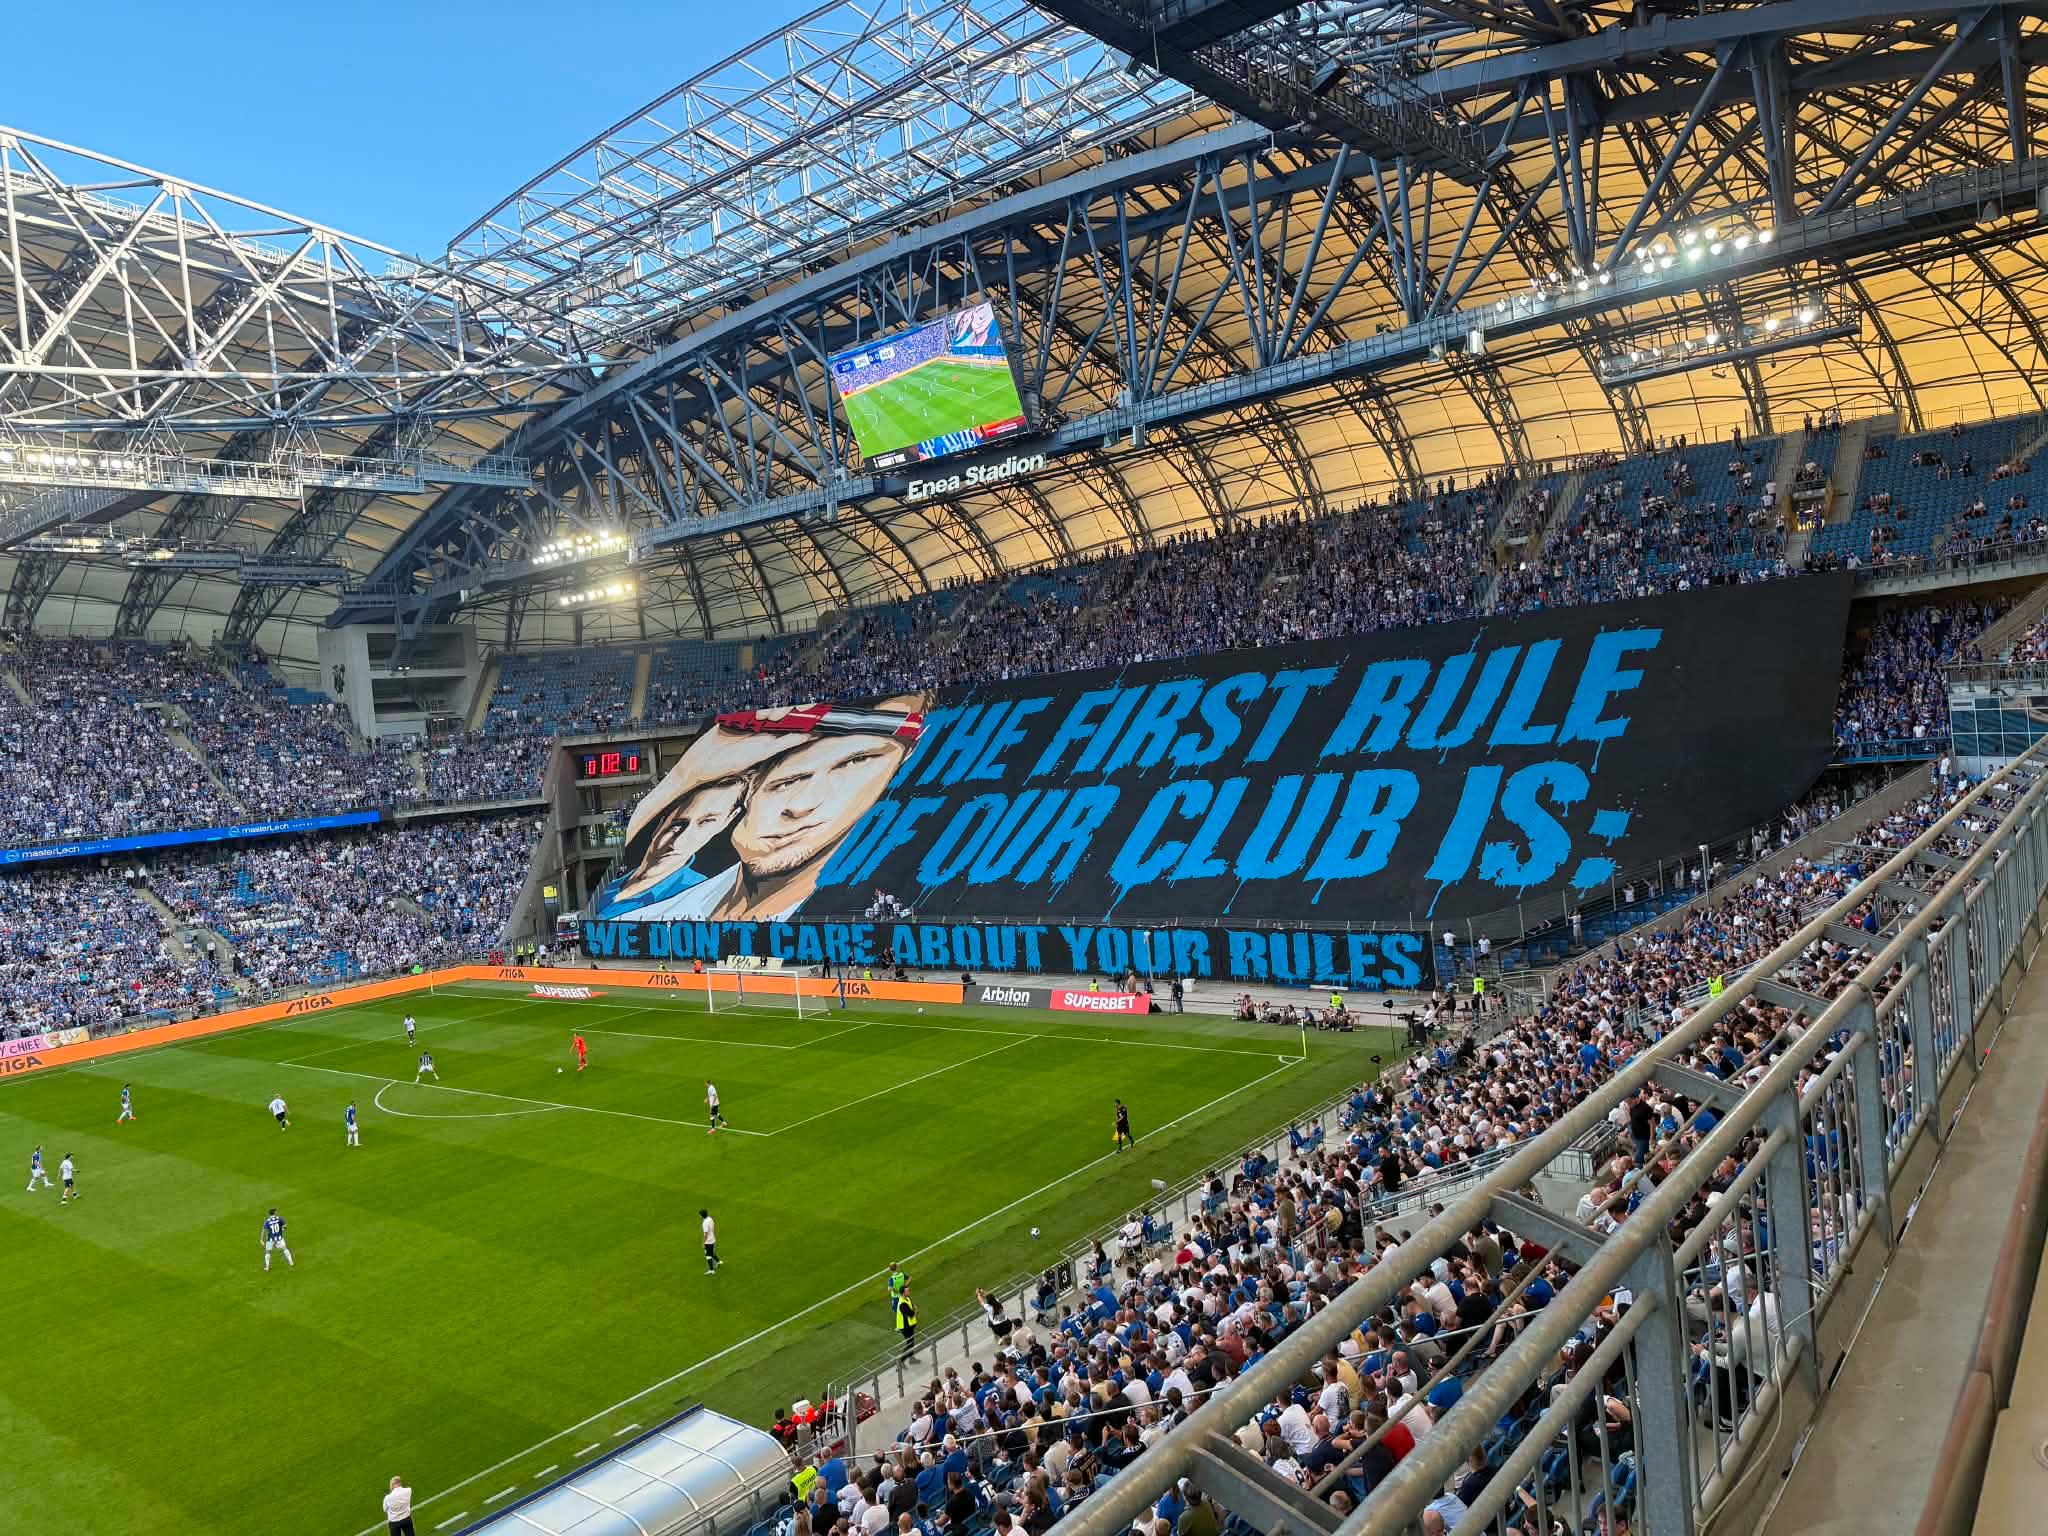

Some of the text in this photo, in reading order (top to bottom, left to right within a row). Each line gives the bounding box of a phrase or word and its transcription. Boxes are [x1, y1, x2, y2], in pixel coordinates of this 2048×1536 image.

[907, 453, 1046, 500] Enea Stadion
[888, 627, 1664, 796] THE FIRST RULE
[588, 760, 597, 776] 0
[601, 752, 621, 774] 02
[629, 756, 639, 771] 0
[812, 760, 1632, 902] OF OUR CLUB IS:
[584, 920, 1422, 987] WE DON'T CARE ABOUT YOUR RULES
[499, 968, 525, 979] STIGA
[648, 974, 680, 986] STIGA
[534, 984, 593, 999] SUPERBET
[981, 986, 1030, 1003] Arbiton
[286, 996, 333, 1014] STIGA
[1064, 992, 1136, 1010] SUPERBET
[270, 1223, 280, 1234] 10
[1061, 1271, 1068, 1283] 3
